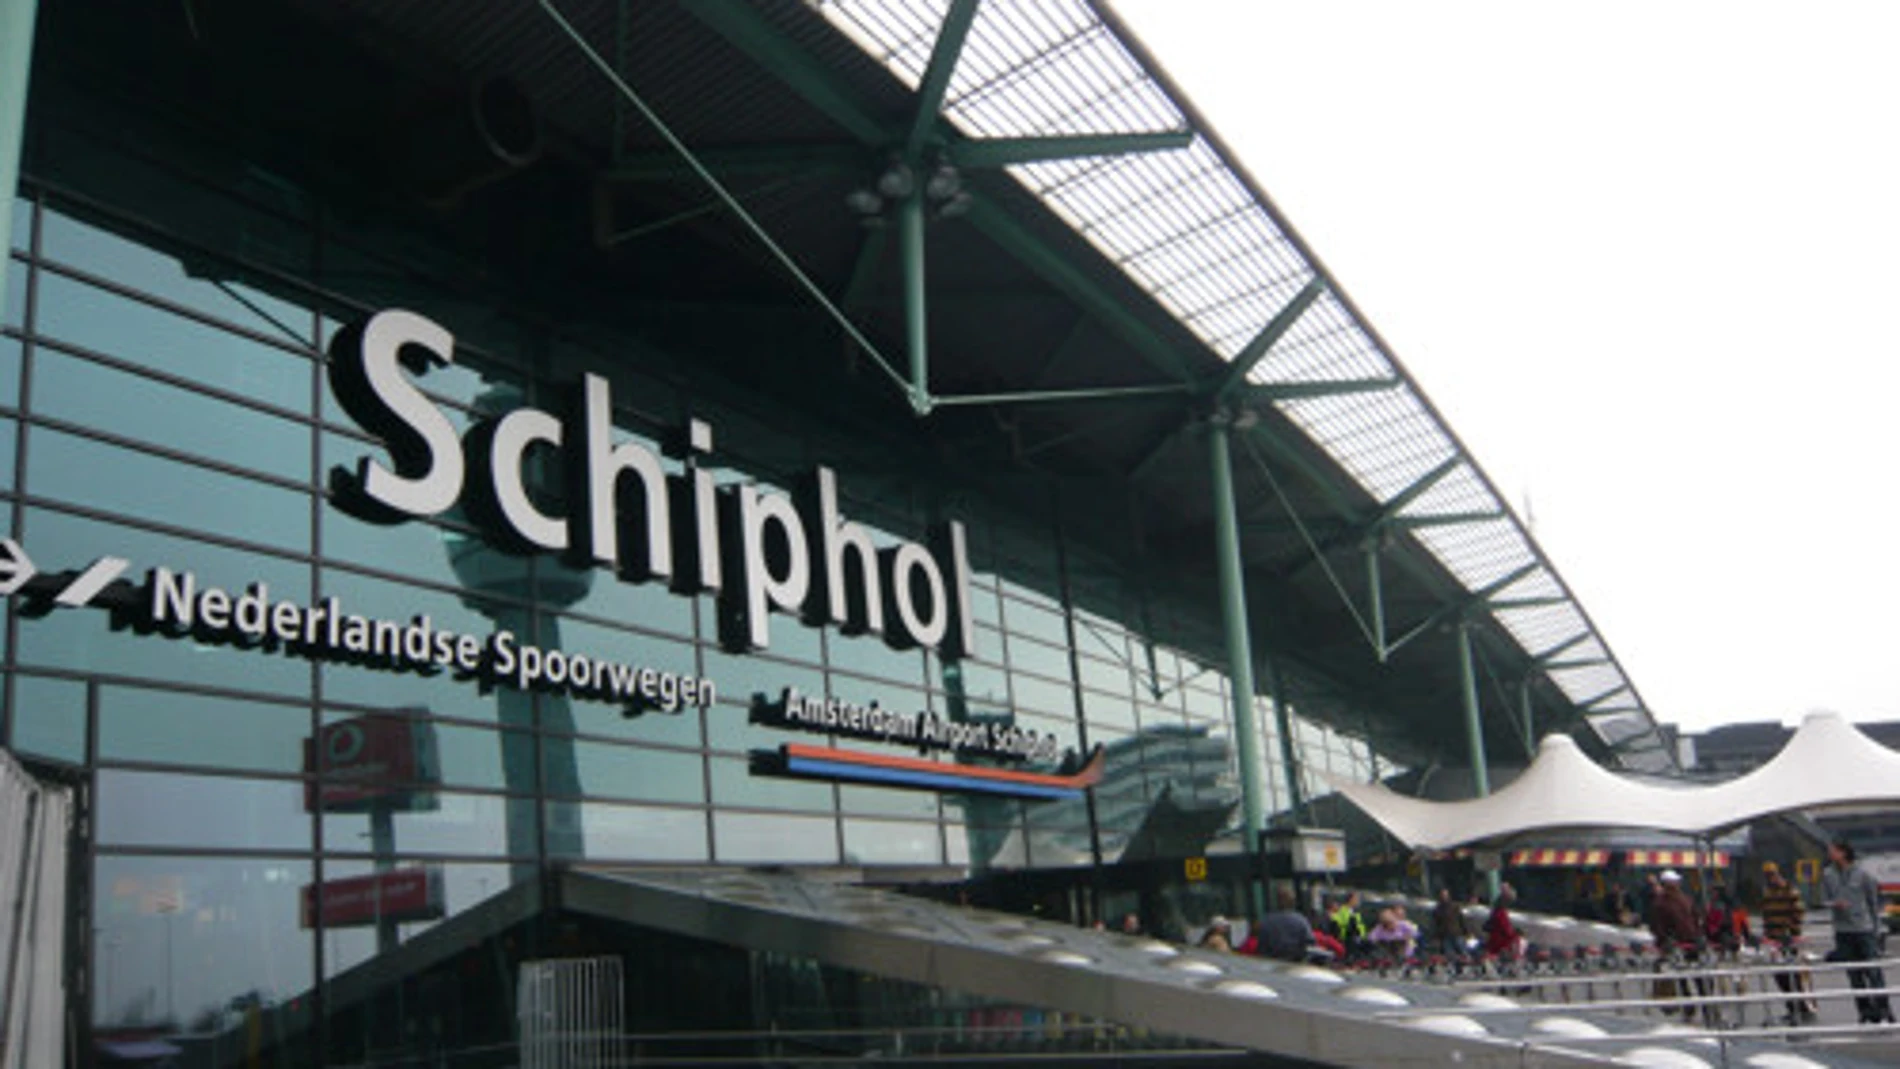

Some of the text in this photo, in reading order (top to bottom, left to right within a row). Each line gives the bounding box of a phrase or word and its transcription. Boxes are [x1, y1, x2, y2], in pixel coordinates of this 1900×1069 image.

[362, 309, 972, 657] Schiphol
[152, 566, 716, 711] Nederlandse Spoorwegen
[785, 685, 917, 739] Amsterdam
[922, 711, 988, 750] Airport
